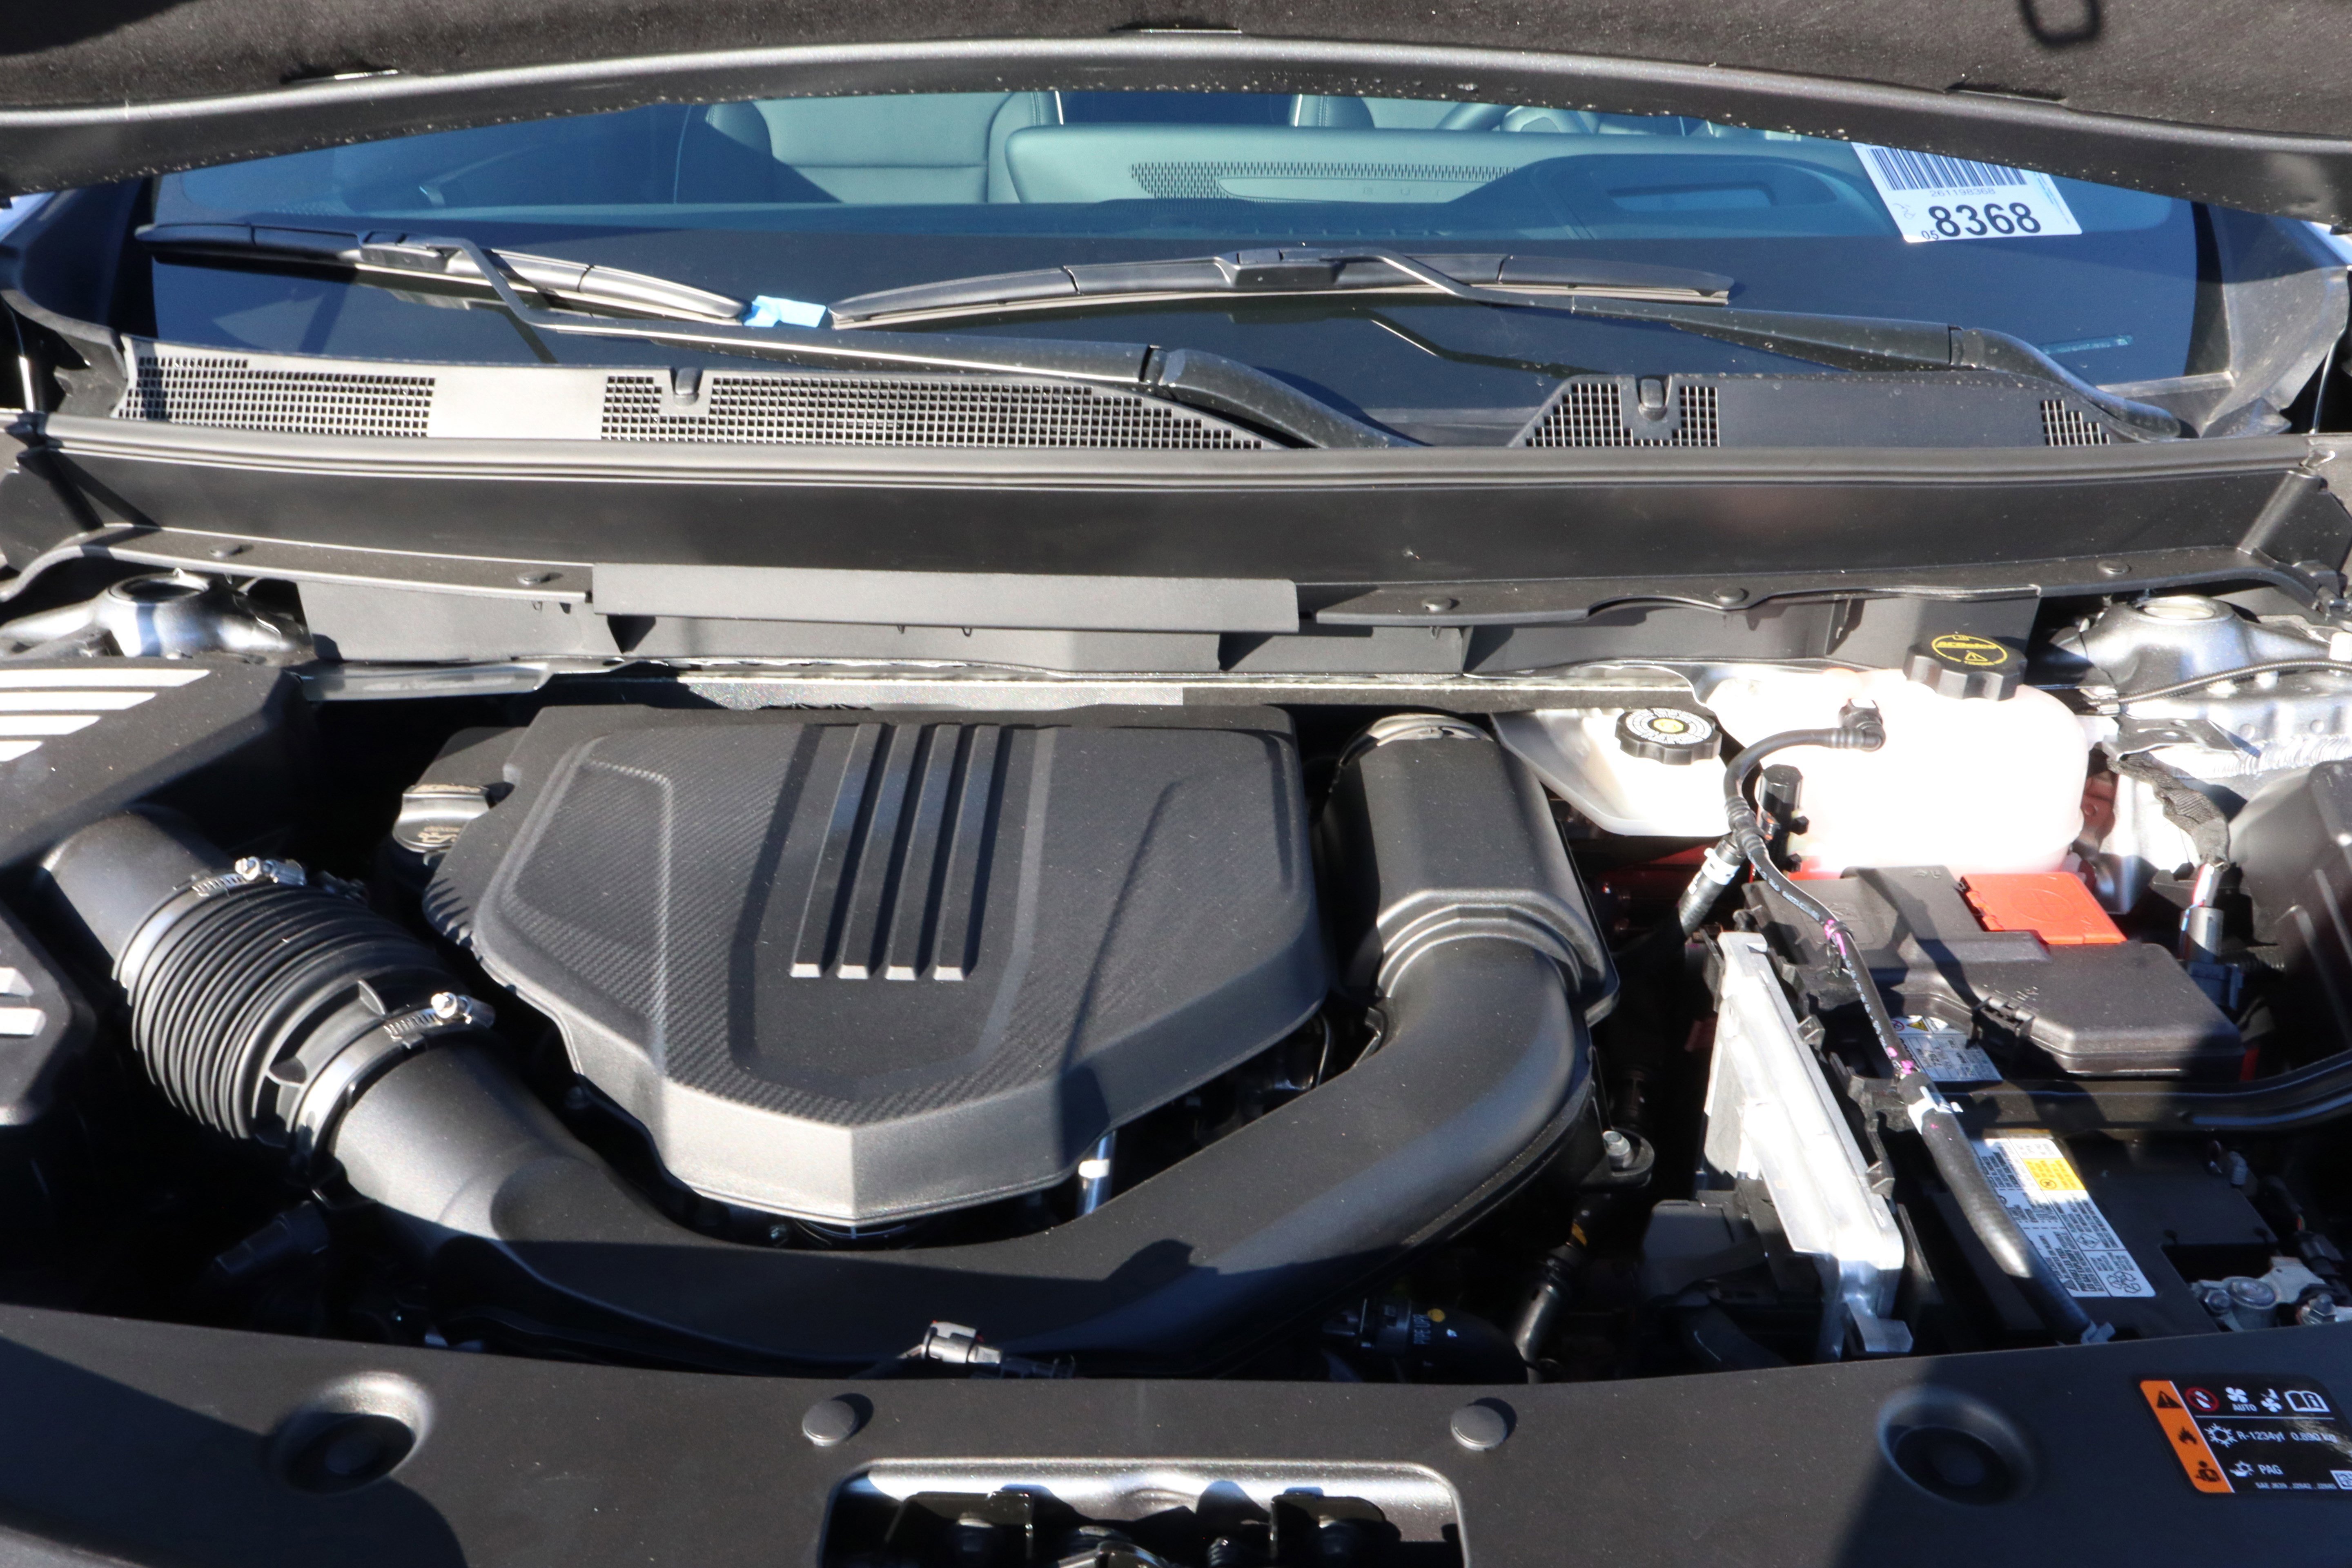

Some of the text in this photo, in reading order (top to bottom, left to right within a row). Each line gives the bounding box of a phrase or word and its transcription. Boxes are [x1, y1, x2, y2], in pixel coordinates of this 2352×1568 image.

[1930, 188, 1996, 197] 261198368
[1928, 203, 2041, 237] 8368
[1921, 230, 1940, 240] 05
[2232, 1403, 2258, 1412] AUTO
[2236, 1430, 2285, 1442] R-1234yf
[2257, 1464, 2284, 1475] PAG
